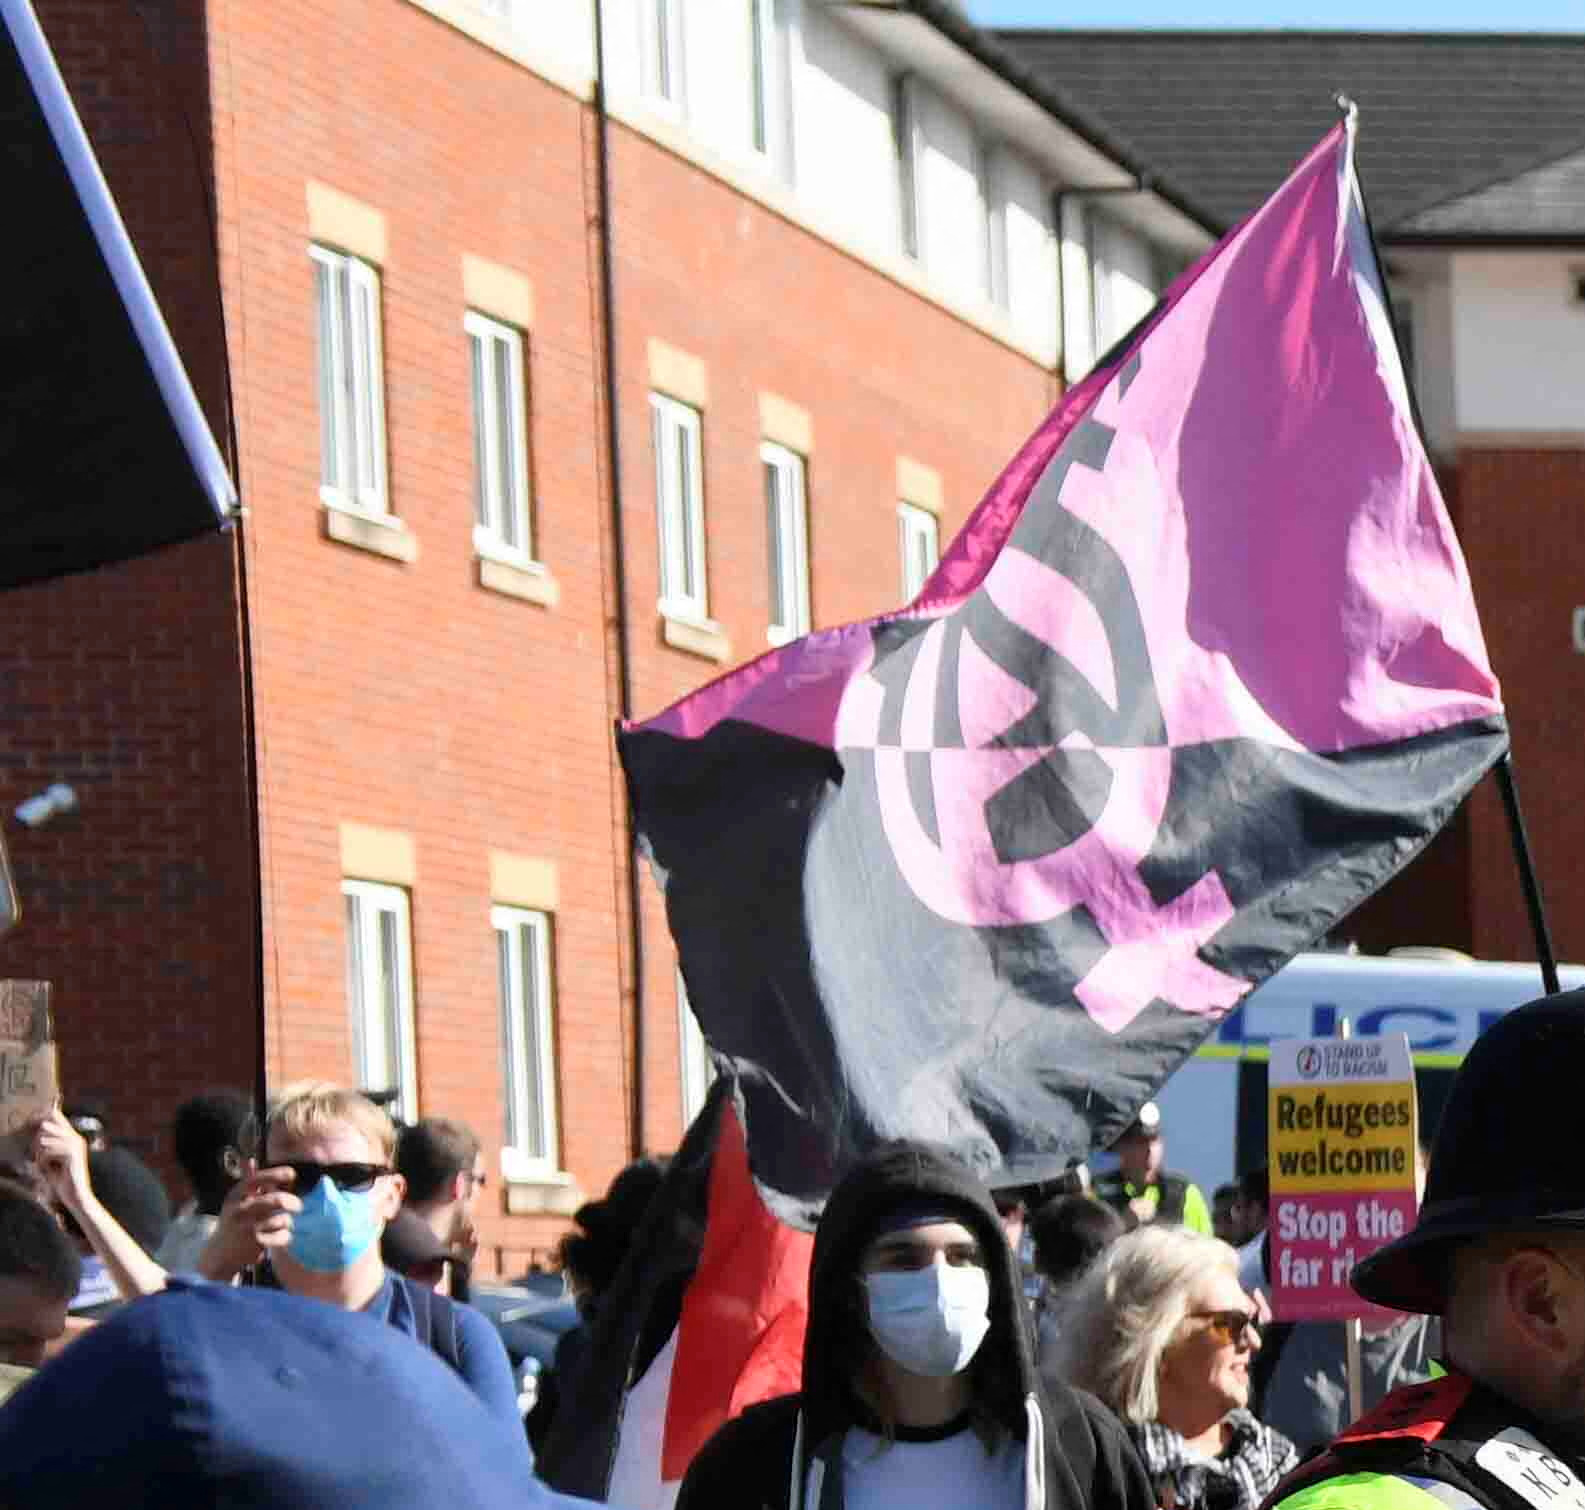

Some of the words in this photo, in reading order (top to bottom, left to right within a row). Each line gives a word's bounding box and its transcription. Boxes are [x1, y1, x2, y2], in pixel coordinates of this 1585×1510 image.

[1277, 1094, 1410, 1138] Refugees
[1277, 1141, 1405, 1175] welcome
[1278, 1201, 1347, 1248] Stop
[1356, 1201, 1404, 1238] the
[1279, 1247, 1323, 1287] far
